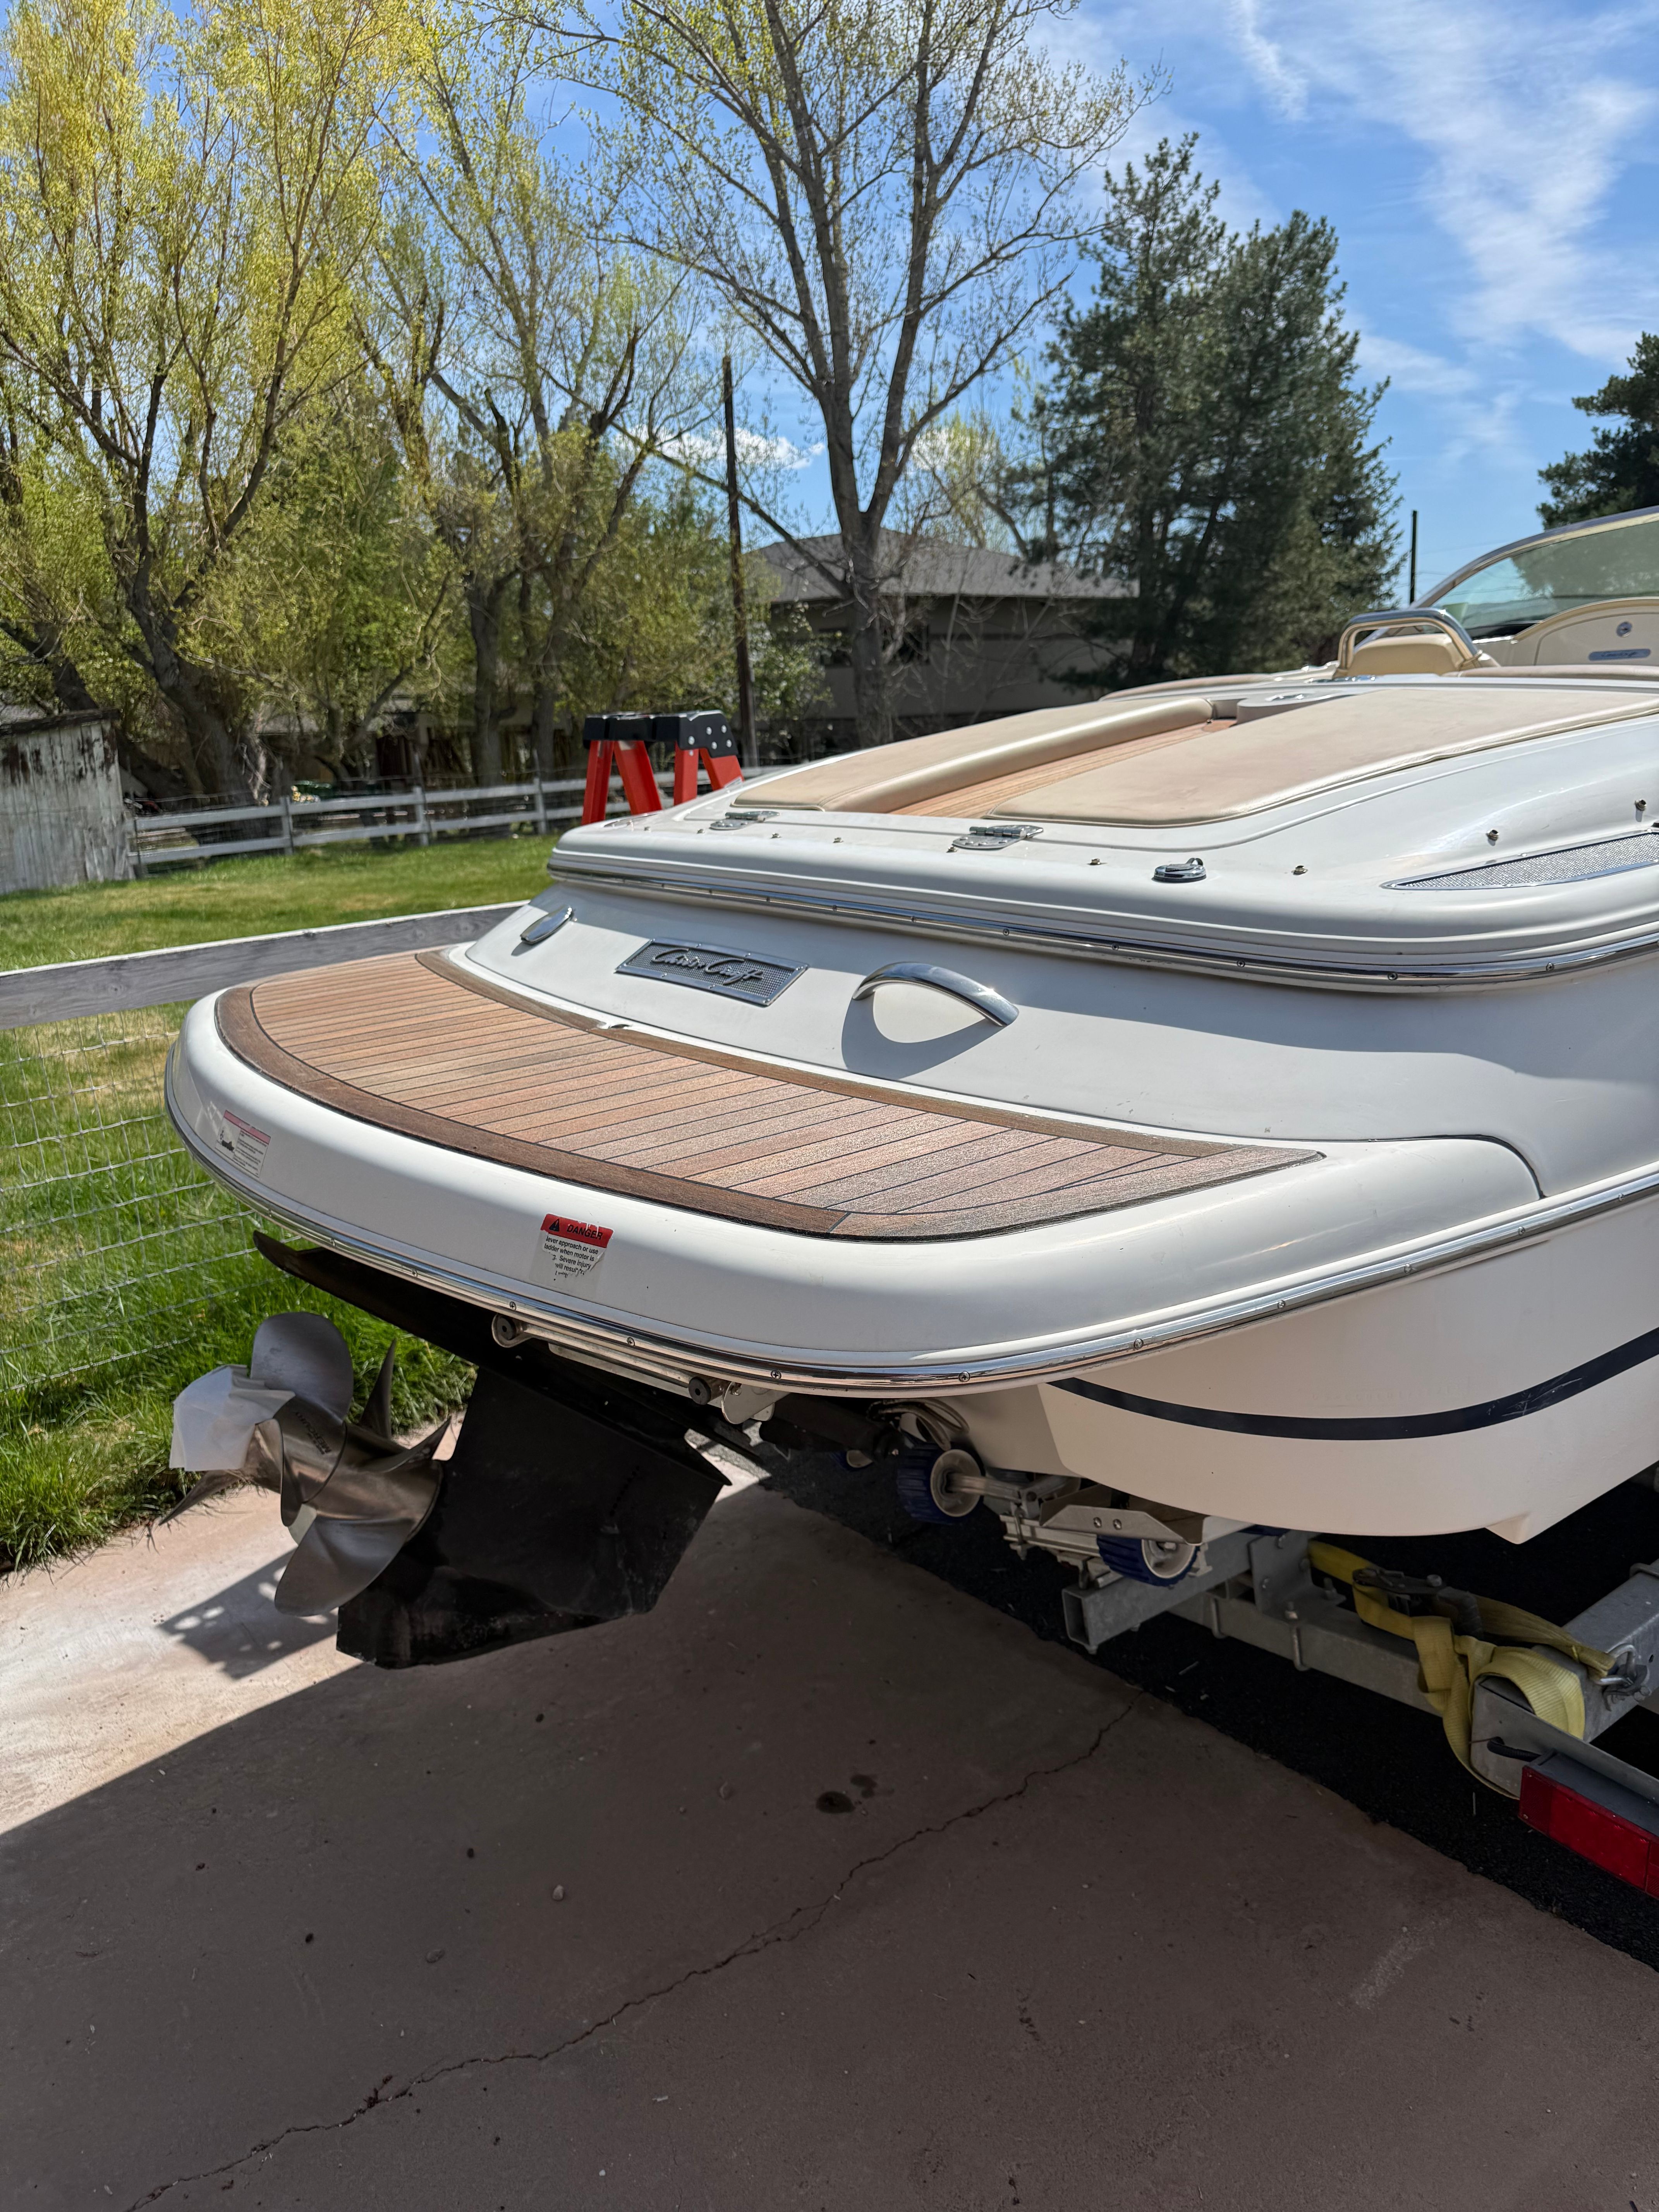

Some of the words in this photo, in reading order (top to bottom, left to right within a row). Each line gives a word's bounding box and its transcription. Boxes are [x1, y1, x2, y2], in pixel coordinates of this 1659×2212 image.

[567, 1224, 603, 1240] DANGER
[544, 1243, 559, 1252] ladder
[559, 1240, 582, 1250] approach
[560, 1255, 576, 1265] Severe
[577, 1260, 592, 1270] injury
